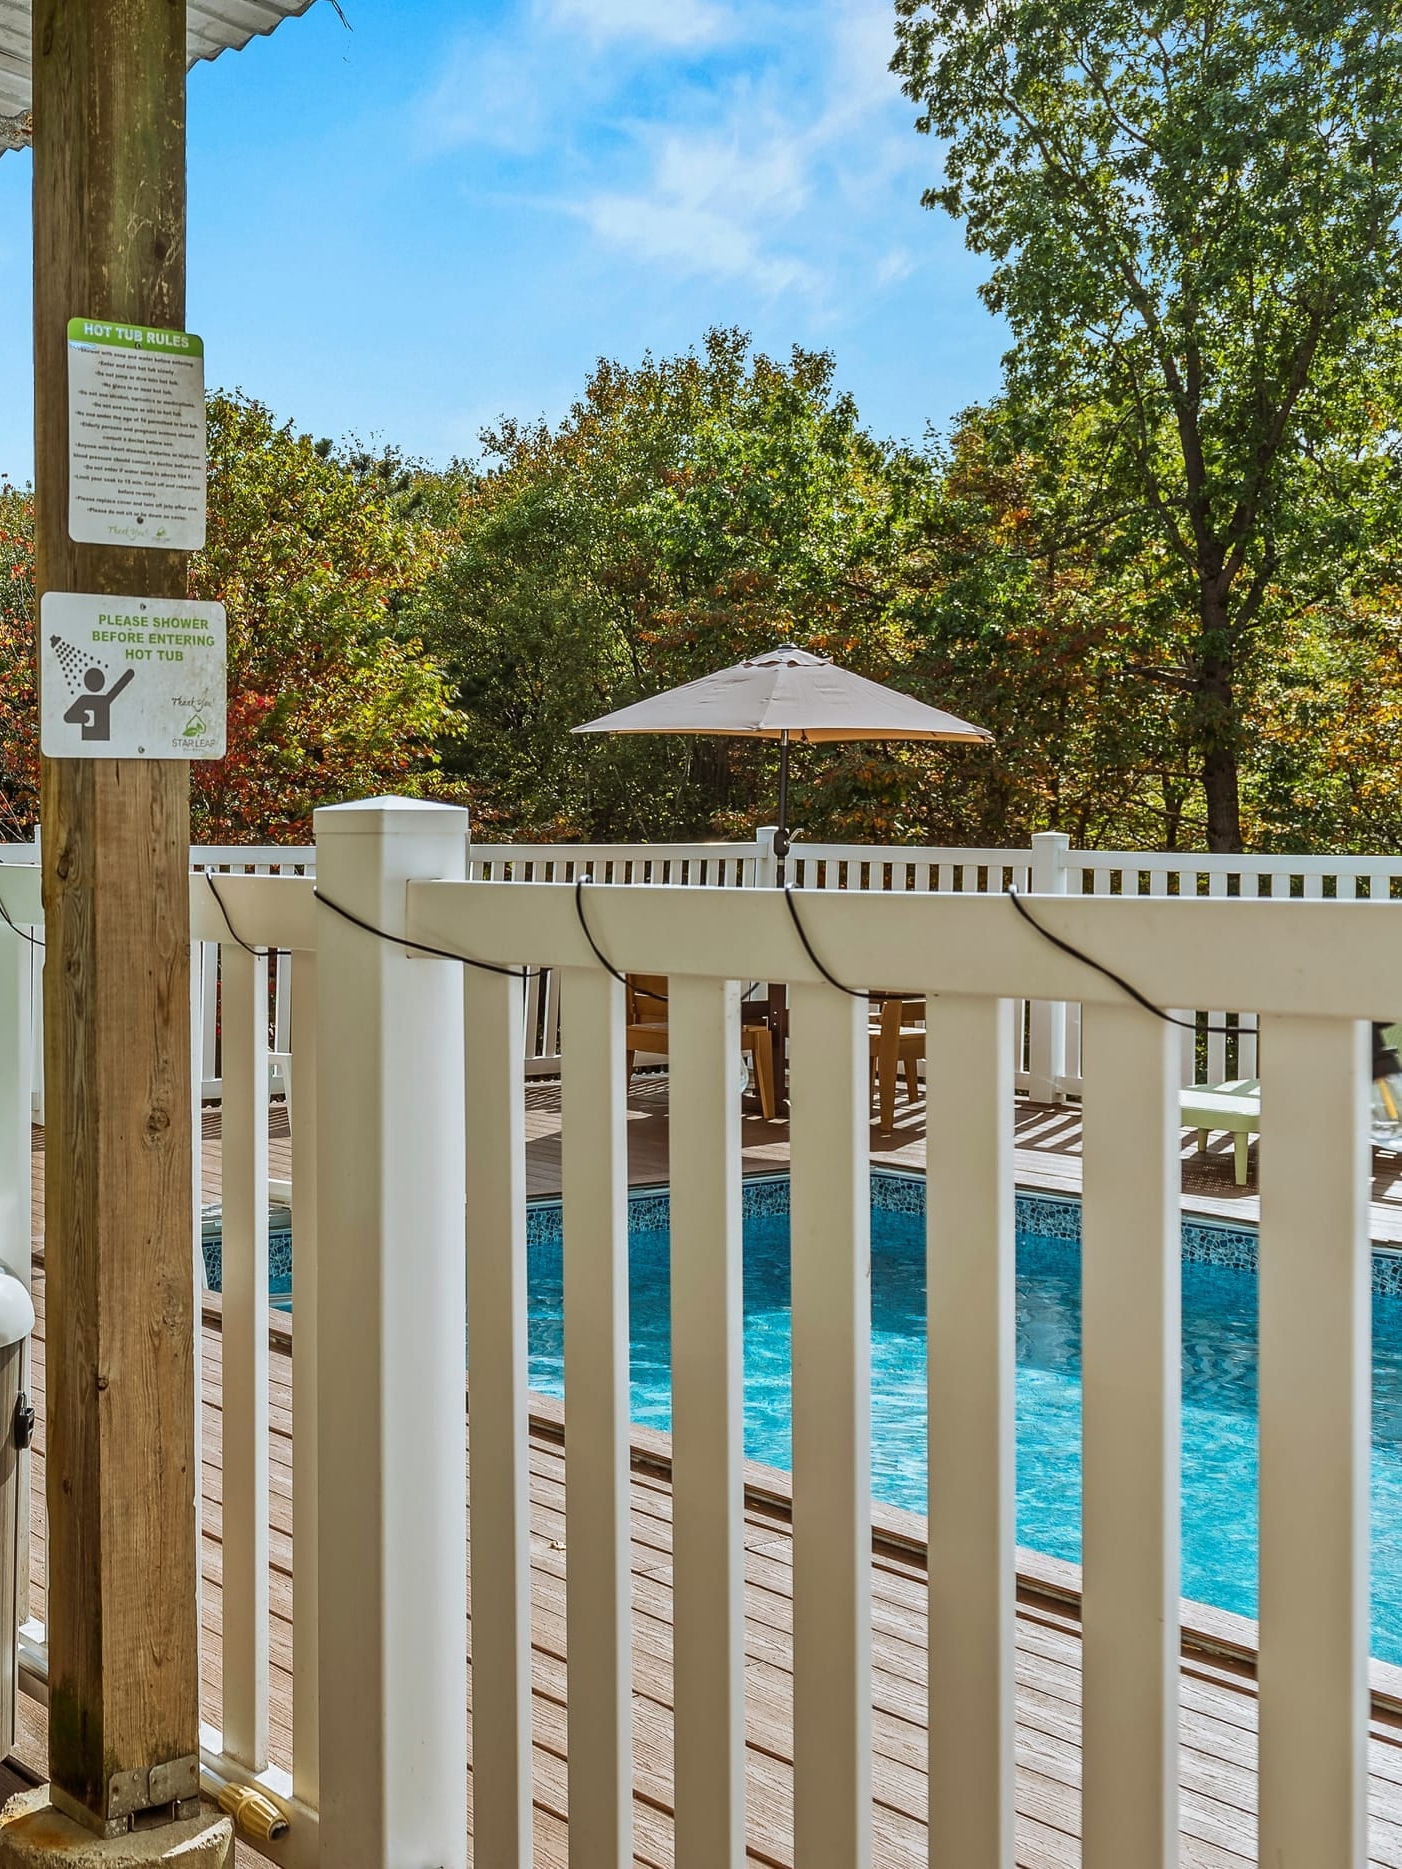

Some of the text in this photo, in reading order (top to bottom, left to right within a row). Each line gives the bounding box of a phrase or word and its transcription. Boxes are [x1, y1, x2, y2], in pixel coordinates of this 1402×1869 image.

[84, 322, 189, 348] HOT TUB RULES
[98, 614, 208, 630] PLEASE SHOWER
[92, 631, 215, 646] BEFORE ENTERING
[126, 649, 184, 662] HOT TUB
[172, 696, 194, 706] Thank
